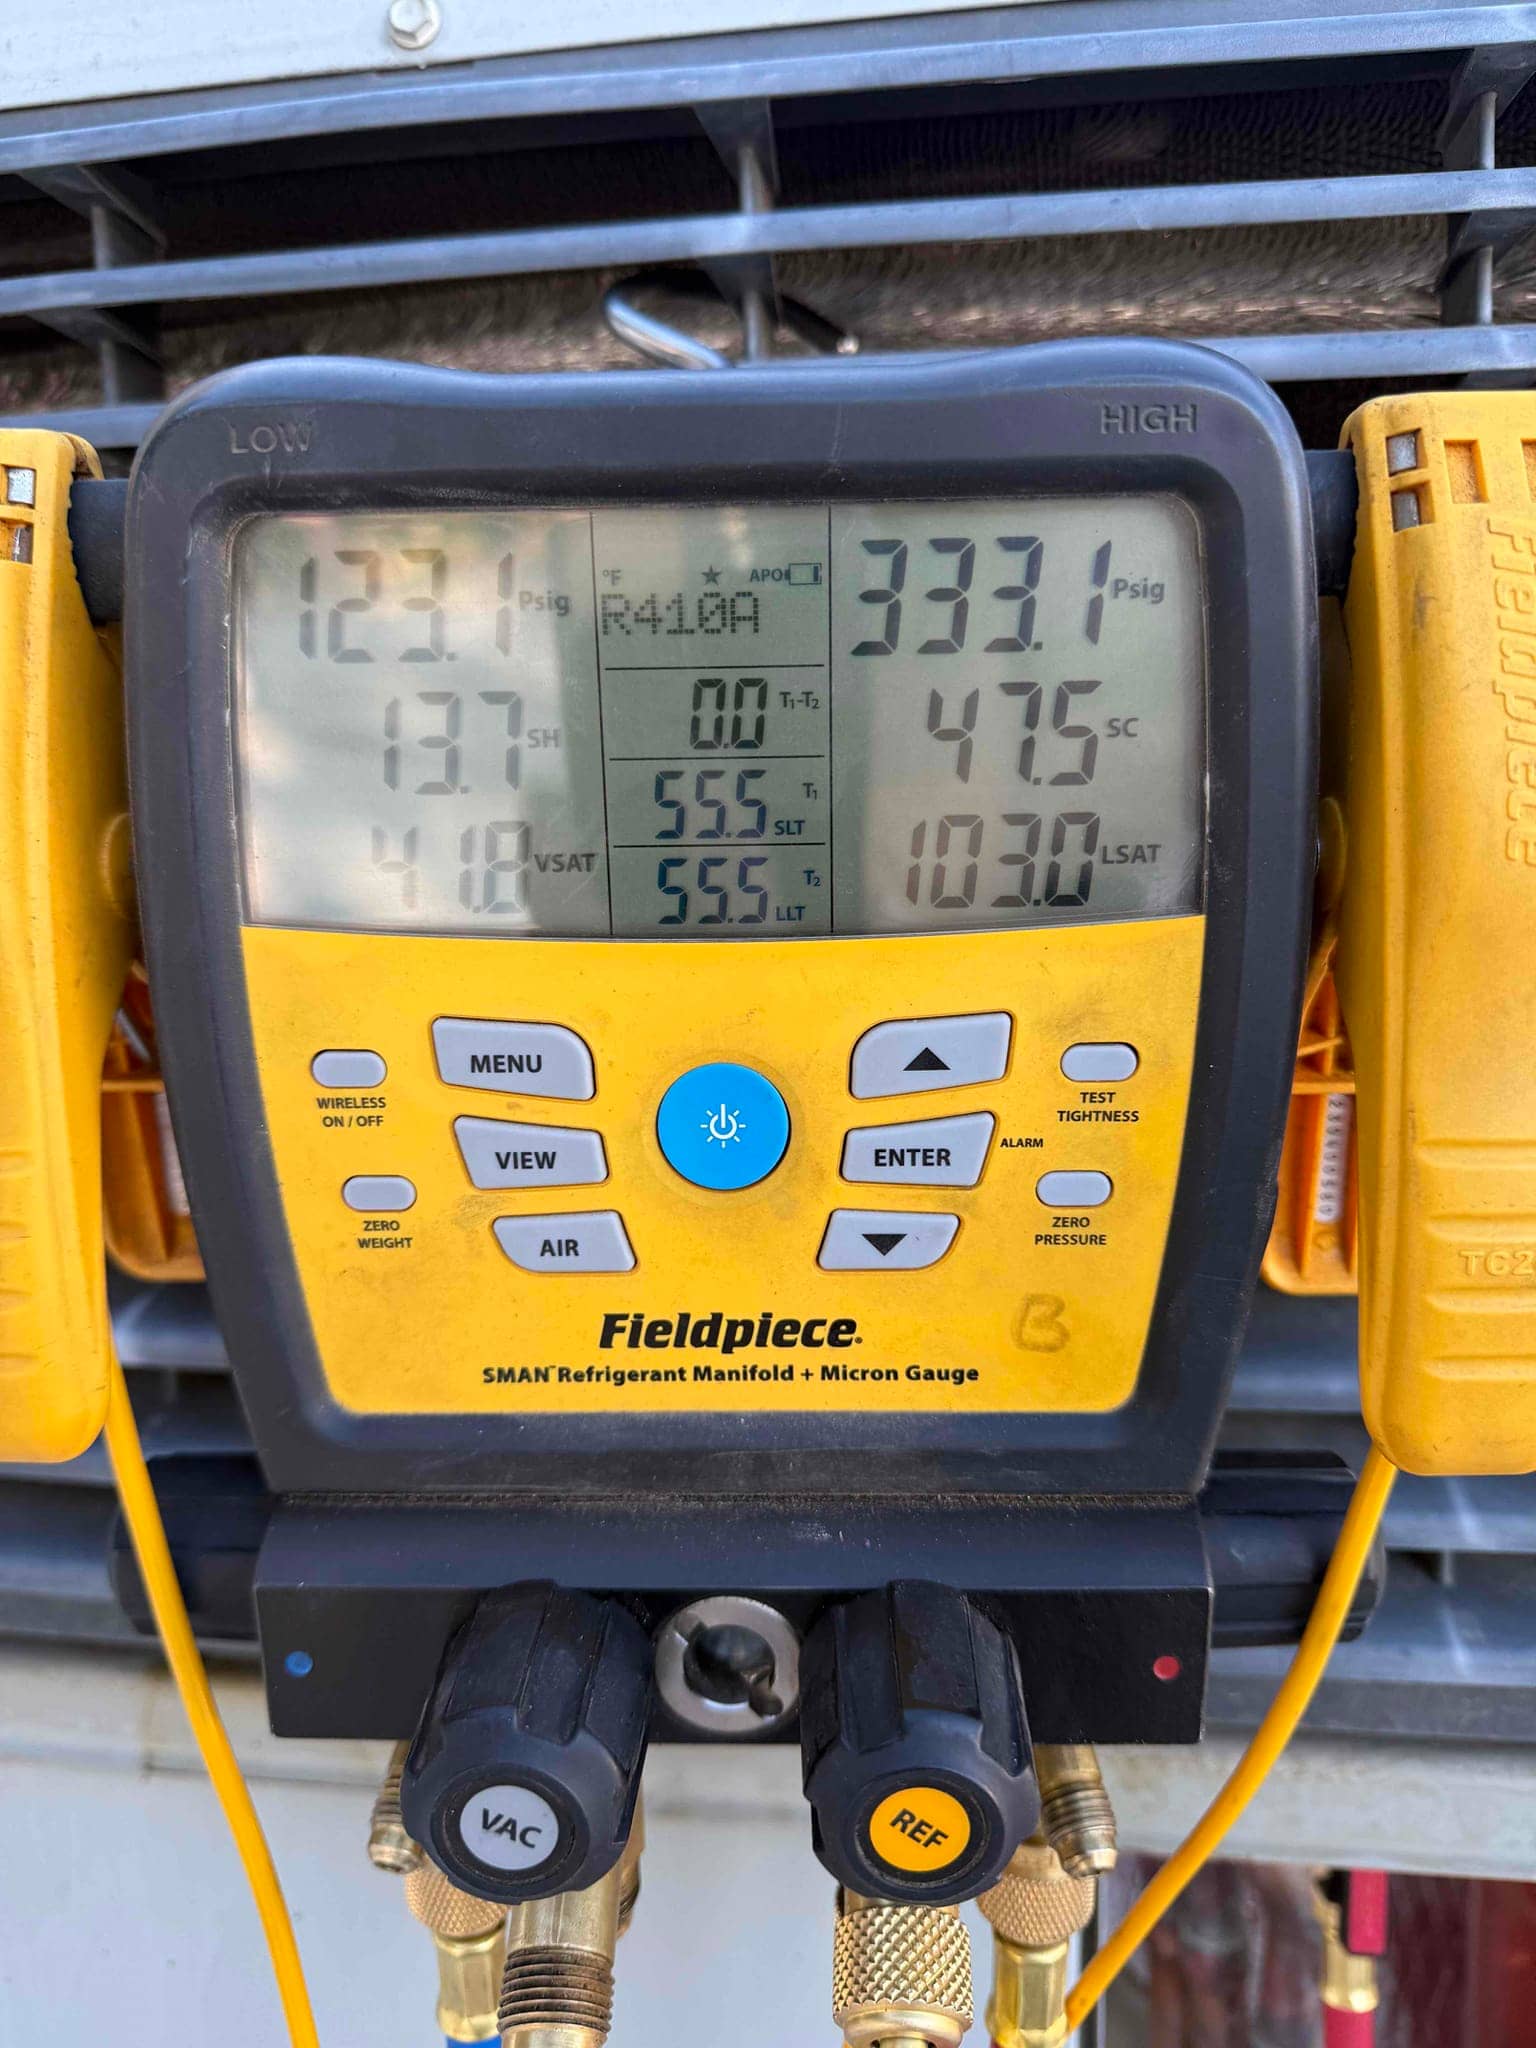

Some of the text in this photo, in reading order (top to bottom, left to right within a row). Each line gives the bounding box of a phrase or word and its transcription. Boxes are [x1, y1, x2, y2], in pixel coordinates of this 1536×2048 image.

[1101, 403, 1197, 435] HIGH
[229, 423, 312, 454] LOW
[749, 569, 783, 584] APO
[851, 535, 1165, 656] 333.1 Psig
[299, 548, 571, 664] 123.1 Psig
[602, 591, 760, 635] R410A
[689, 678, 769, 750] 0.0
[528, 729, 561, 749] SH
[927, 681, 1139, 786] 47.5 SC
[655, 769, 768, 840] 55.5
[774, 820, 806, 836] SLT
[534, 853, 597, 874] VSAT
[906, 812, 1162, 909] 103.0 LSAT
[658, 857, 769, 925] 55.5
[776, 906, 807, 922] LLT
[470, 1054, 543, 1074] MENU
[316, 1096, 387, 1110] WIRELESS
[1080, 1091, 1116, 1104] TEST
[322, 1115, 345, 1128] ON
[356, 1115, 384, 1128] OFF
[1057, 1110, 1140, 1123] TIGHTNESS
[1000, 1138, 1044, 1149] ALARM
[495, 1151, 557, 1170] VIEW
[874, 1148, 951, 1168] ENTER
[363, 1220, 400, 1232] ZERO
[1052, 1216, 1090, 1229] ZERO
[357, 1237, 413, 1249] WEIGHT
[540, 1239, 579, 1257] AIR
[1035, 1234, 1107, 1246] PRESSURE
[1010, 1292, 1070, 1353] B
[557, 1365, 687, 1386] Refrigerant
[693, 1364, 794, 1382] Manifold
[821, 1364, 899, 1382] Micron
[905, 1364, 979, 1385] Gauge
[481, 1808, 542, 1849] VAC
[889, 1807, 949, 1850] REF
